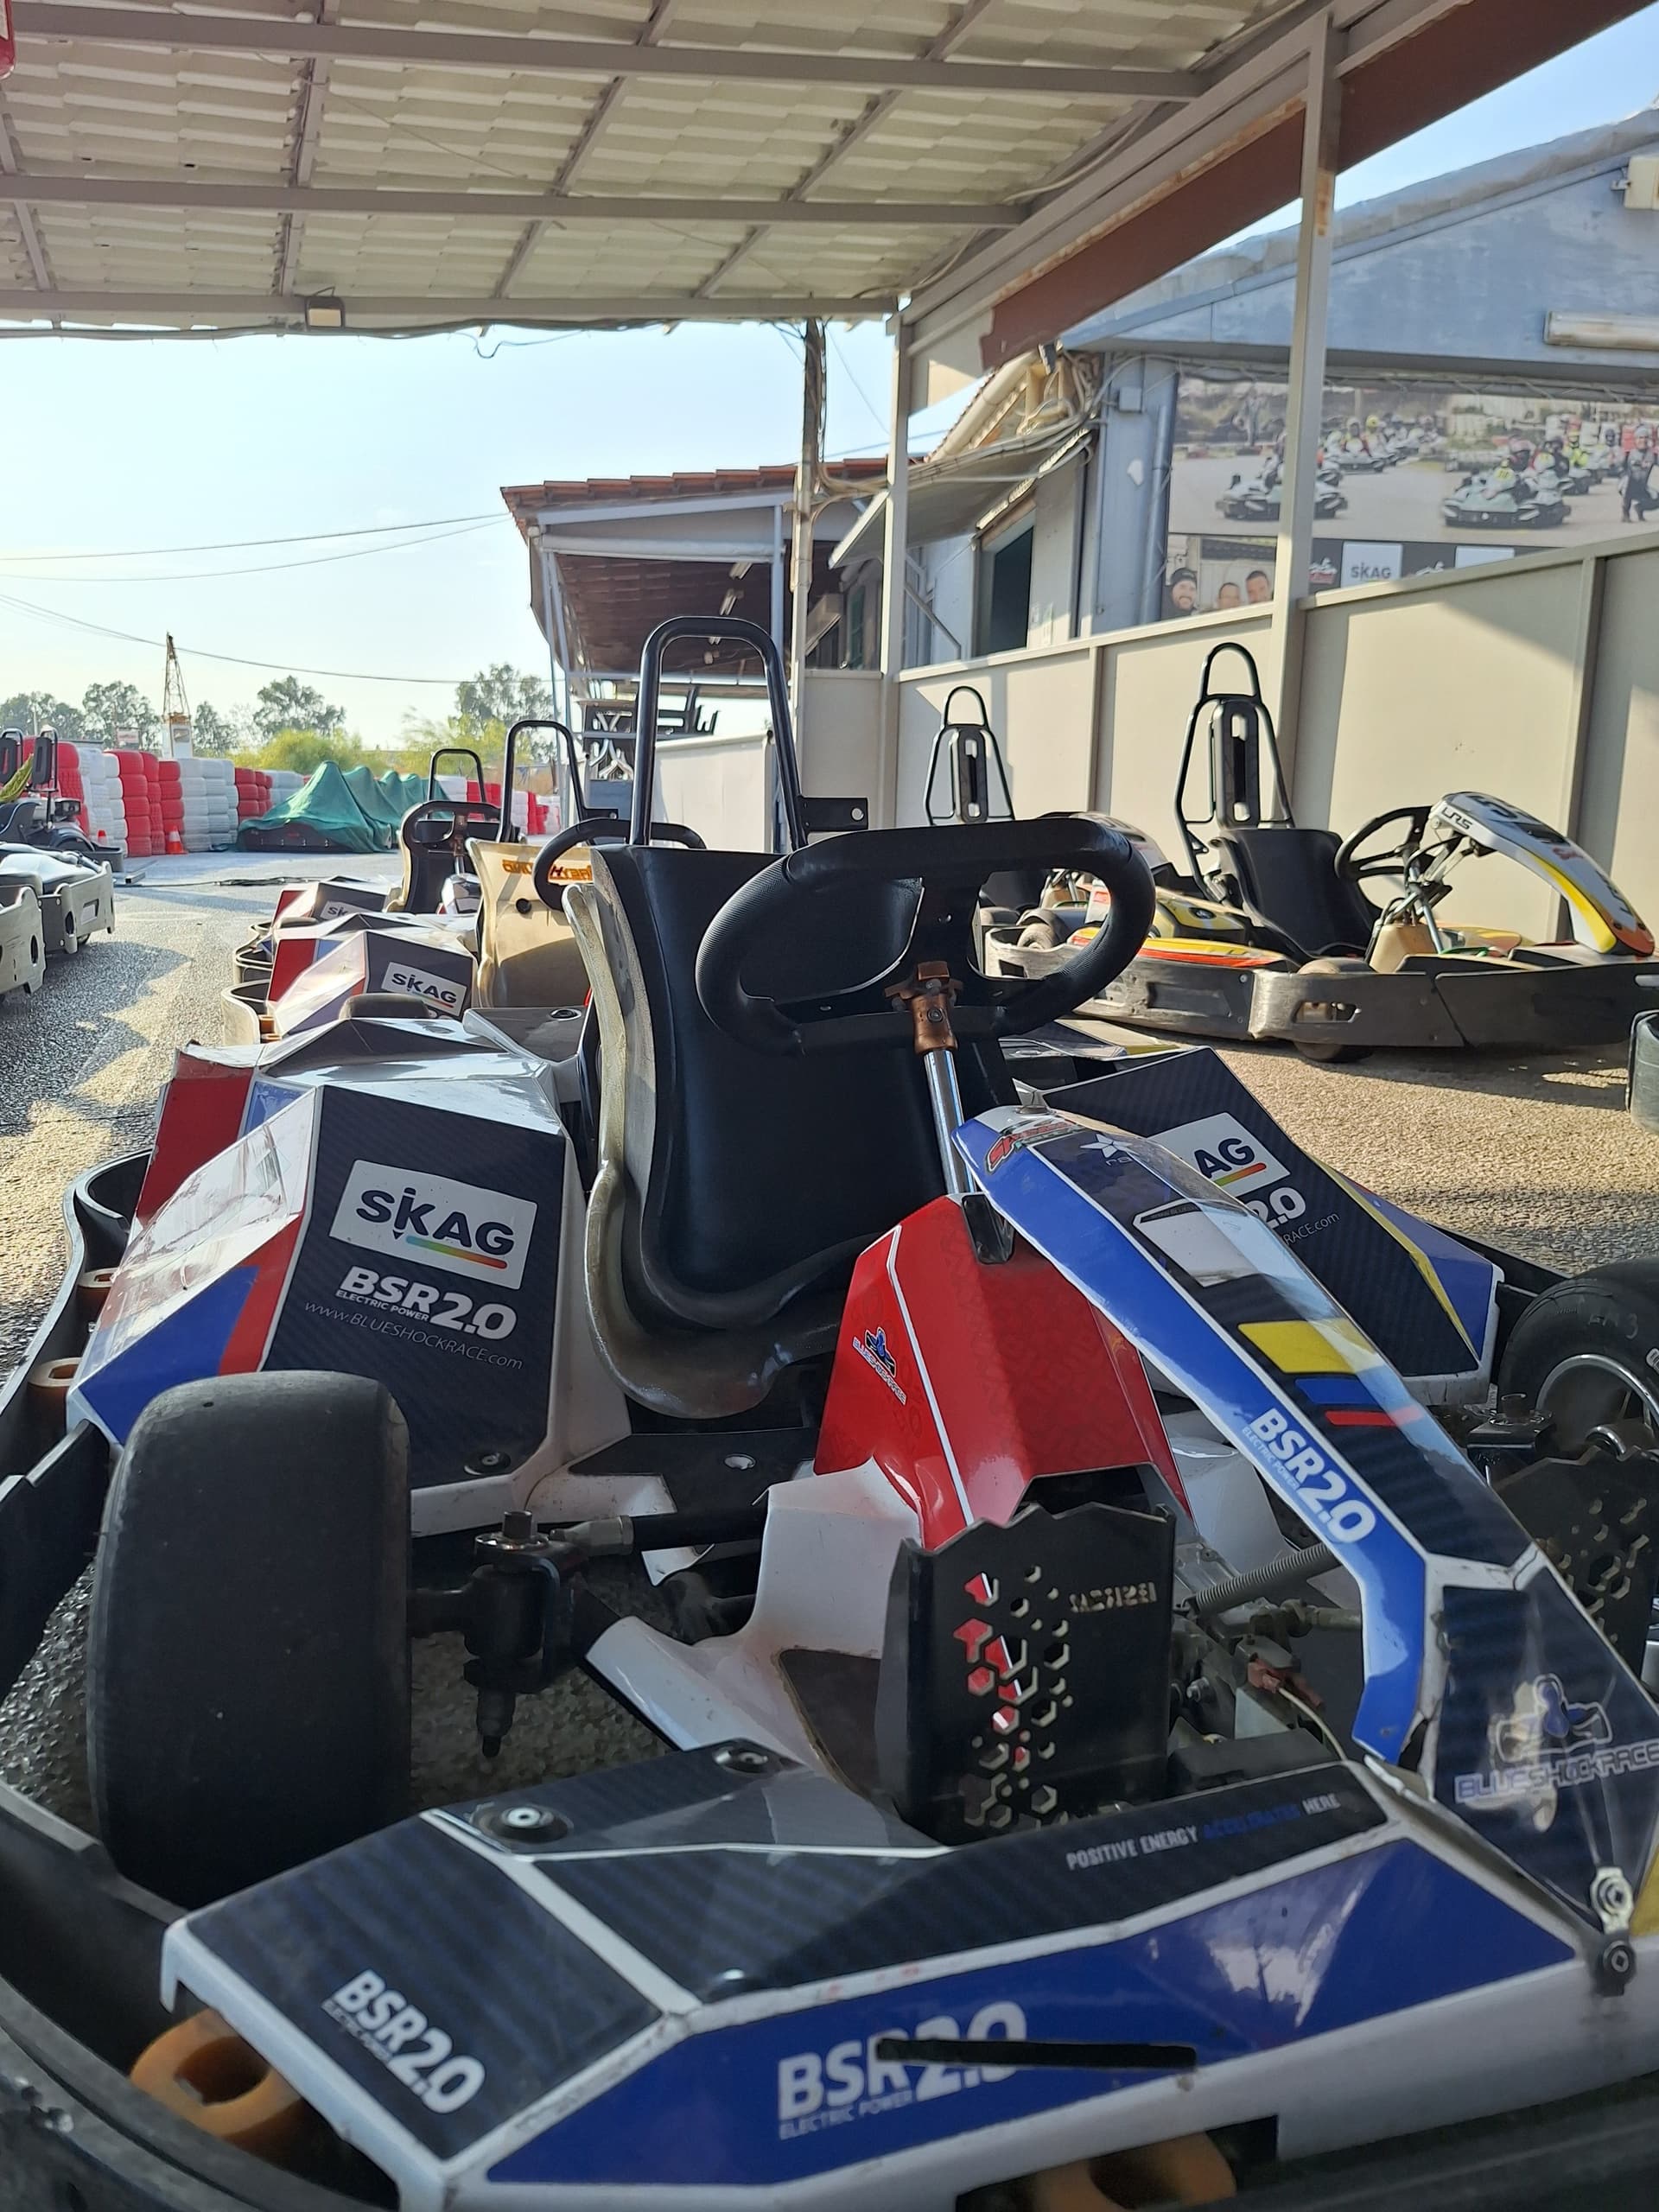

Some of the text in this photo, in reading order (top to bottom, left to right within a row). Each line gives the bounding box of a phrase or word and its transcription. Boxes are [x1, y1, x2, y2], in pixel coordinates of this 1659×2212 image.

[1440, 806, 1473, 830] LRS
[1193, 1138, 1255, 1179] AG
[305, 1301, 523, 1370] www.BLUESHOCKRACE.com
[335, 1289, 429, 1323] ELECTRIC POWER
[340, 1266, 517, 1340] BSR2.0
[1250, 1408, 1376, 1543] BSR2.0
[1066, 1839, 1138, 1871] POSITIVE
[1140, 1825, 1198, 1854] ENERGY
[1302, 1793, 1340, 1815] HERE
[333, 1968, 486, 2114] BSR2.0
[779, 2000, 1027, 2120] BSR2.0
